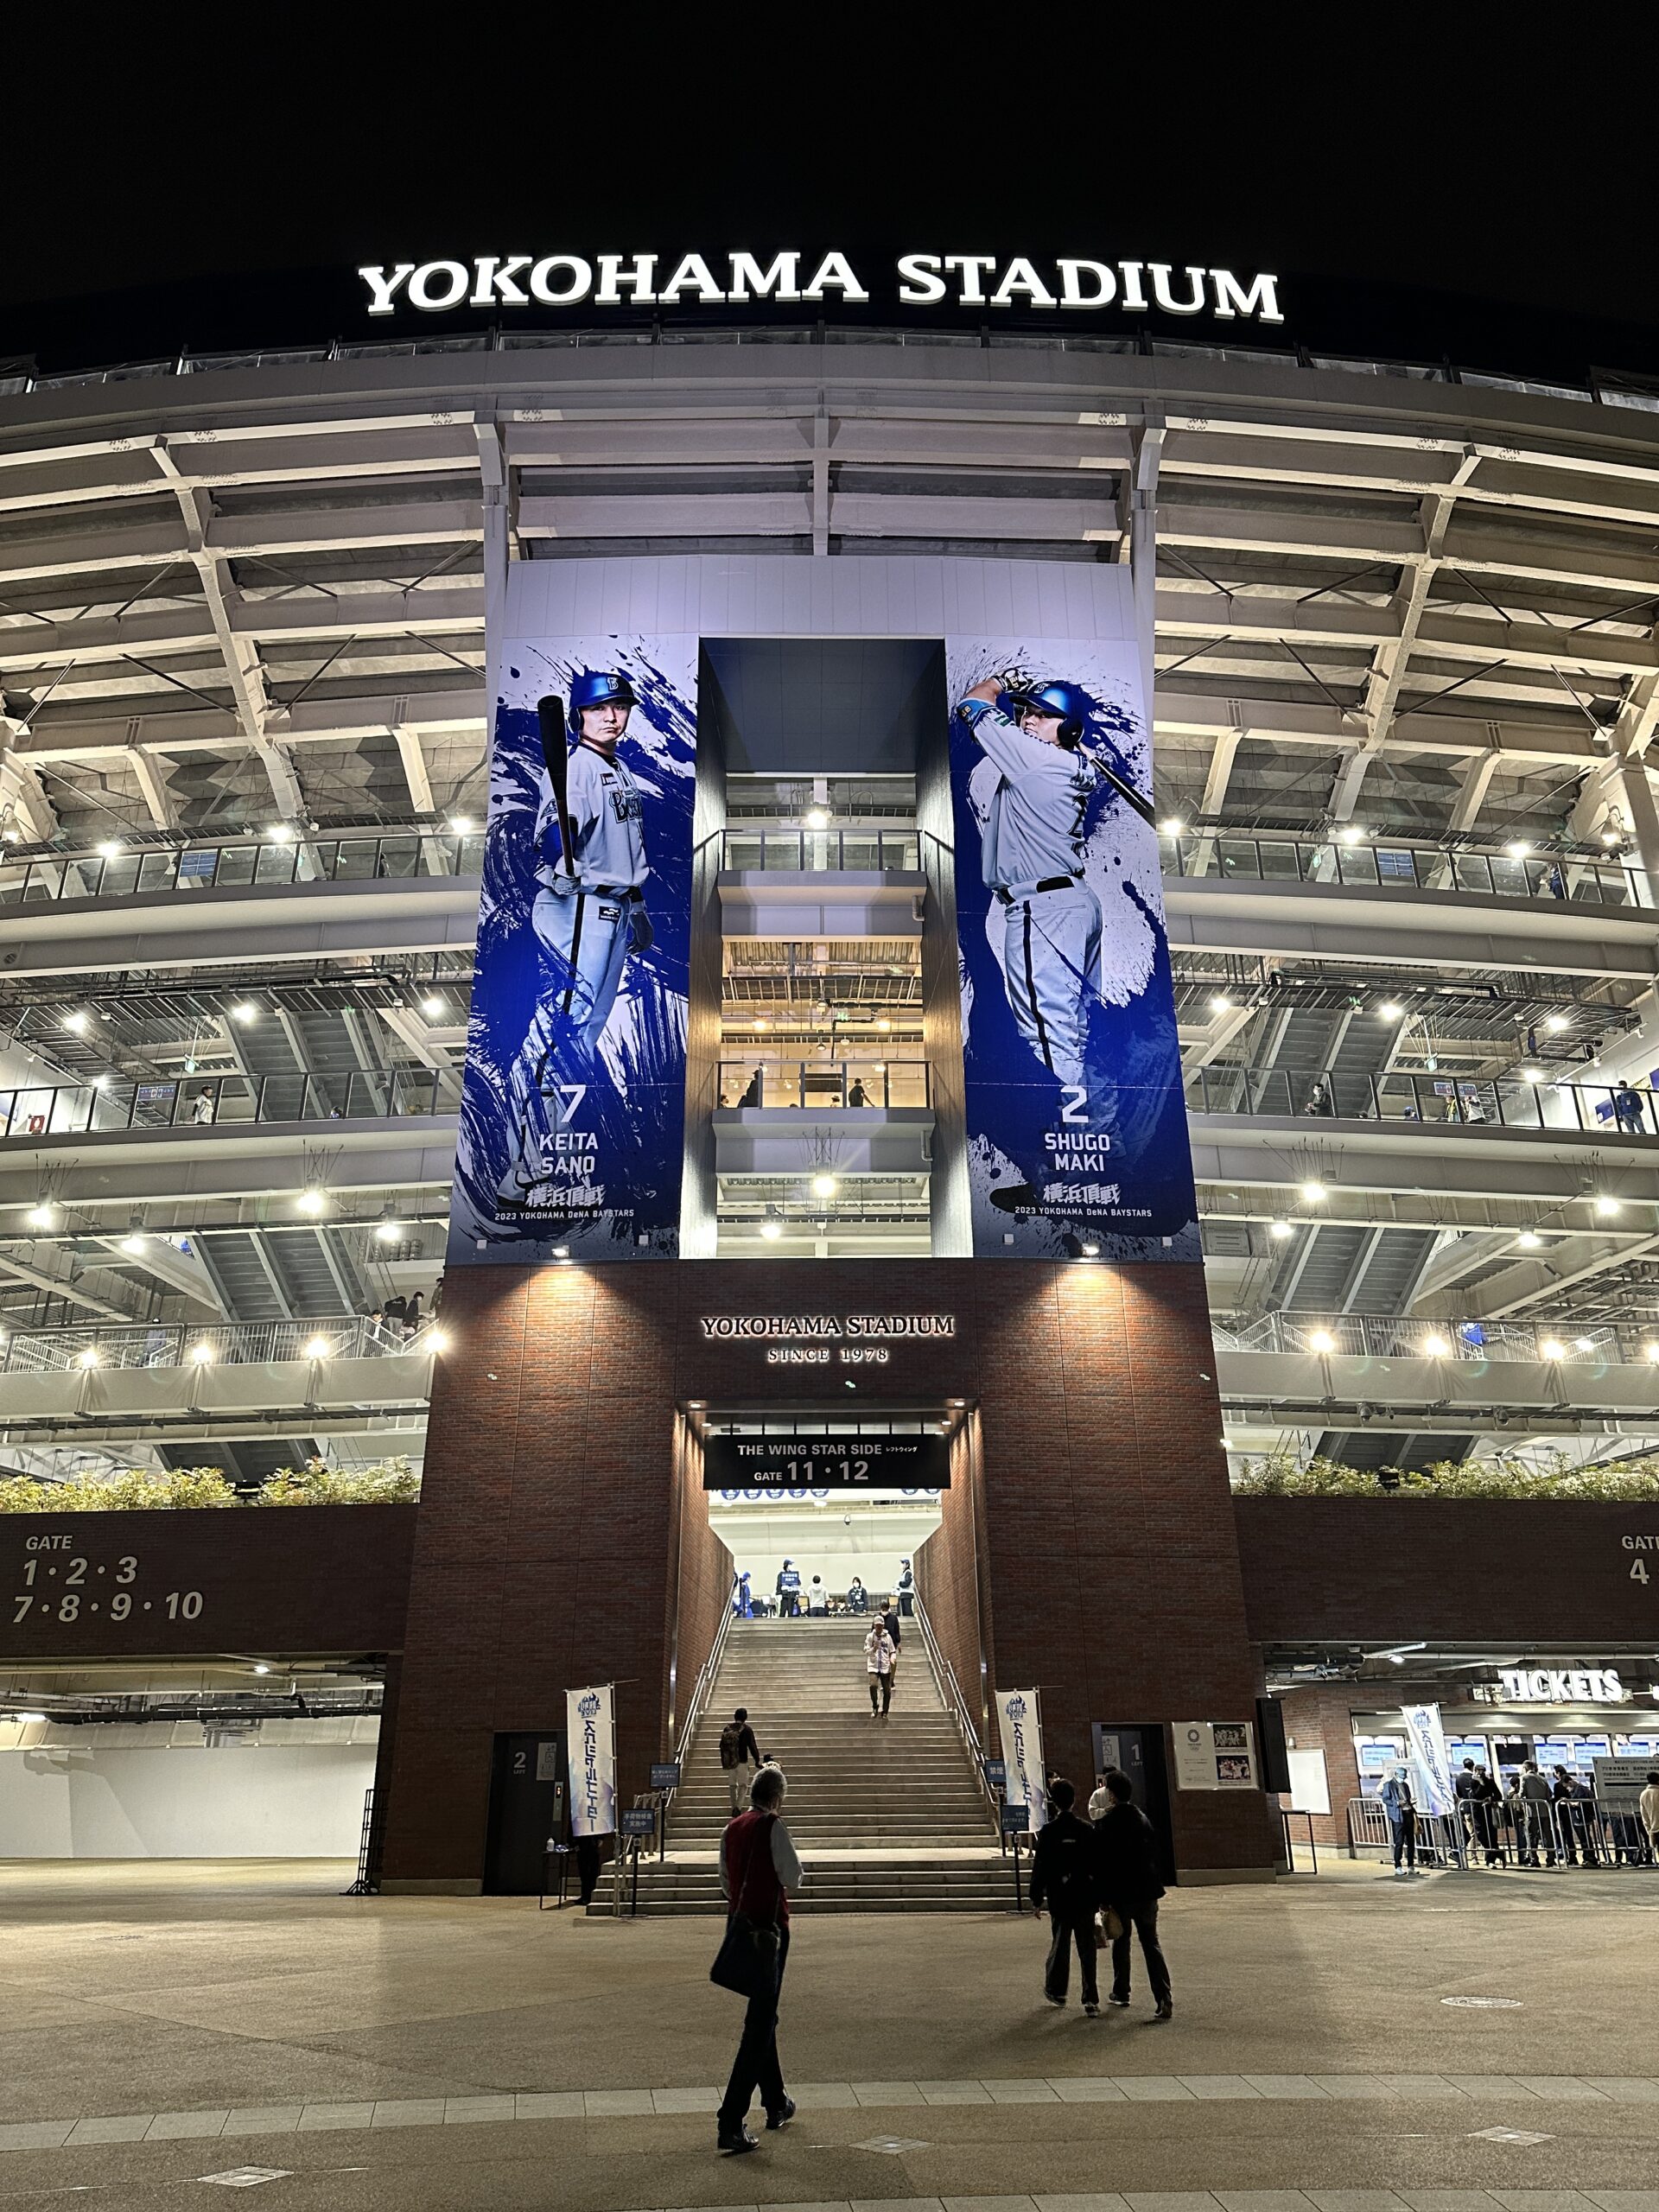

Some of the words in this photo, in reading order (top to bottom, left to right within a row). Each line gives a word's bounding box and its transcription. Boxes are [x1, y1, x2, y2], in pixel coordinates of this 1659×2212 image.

[359, 251, 869, 316] YOKOHAMA
[897, 254, 1285, 324] STADIUM
[560, 1084, 587, 1122] 7
[1060, 1085, 1089, 1123] 2
[539, 1133, 599, 1151] KEITA
[1044, 1133, 1110, 1151] SHUGO
[541, 1155, 595, 1175] SANO
[1054, 1154, 1105, 1172] MAKI
[494, 1212, 517, 1221] 2023
[519, 1211, 564, 1220] YOKOHAMA
[568, 1210, 589, 1218] DeNA
[592, 1209, 634, 1217] BAYSTARS
[1039, 1207, 1083, 1216] YOKOHAMA
[1086, 1208, 1108, 1217] DeNA
[1110, 1209, 1153, 1217] BAYSTARS
[701, 1316, 842, 1337] YOKOHAMA
[847, 1315, 955, 1337] STADIUM
[767, 1348, 830, 1362] SINCE
[841, 1348, 889, 1362] 1978
[737, 1445, 764, 1456] THE
[768, 1445, 807, 1456] WING
[811, 1445, 847, 1455] STAR
[850, 1444, 882, 1455] SIDE
[753, 1471, 783, 1481] GATE
[25, 1535, 73, 1550] GATE
[1630, 1558, 1650, 1585] 4
[1497, 1669, 1623, 1703] TICKETS
[513, 1751, 526, 1769] 2
[1131, 1744, 1141, 1761] 1
